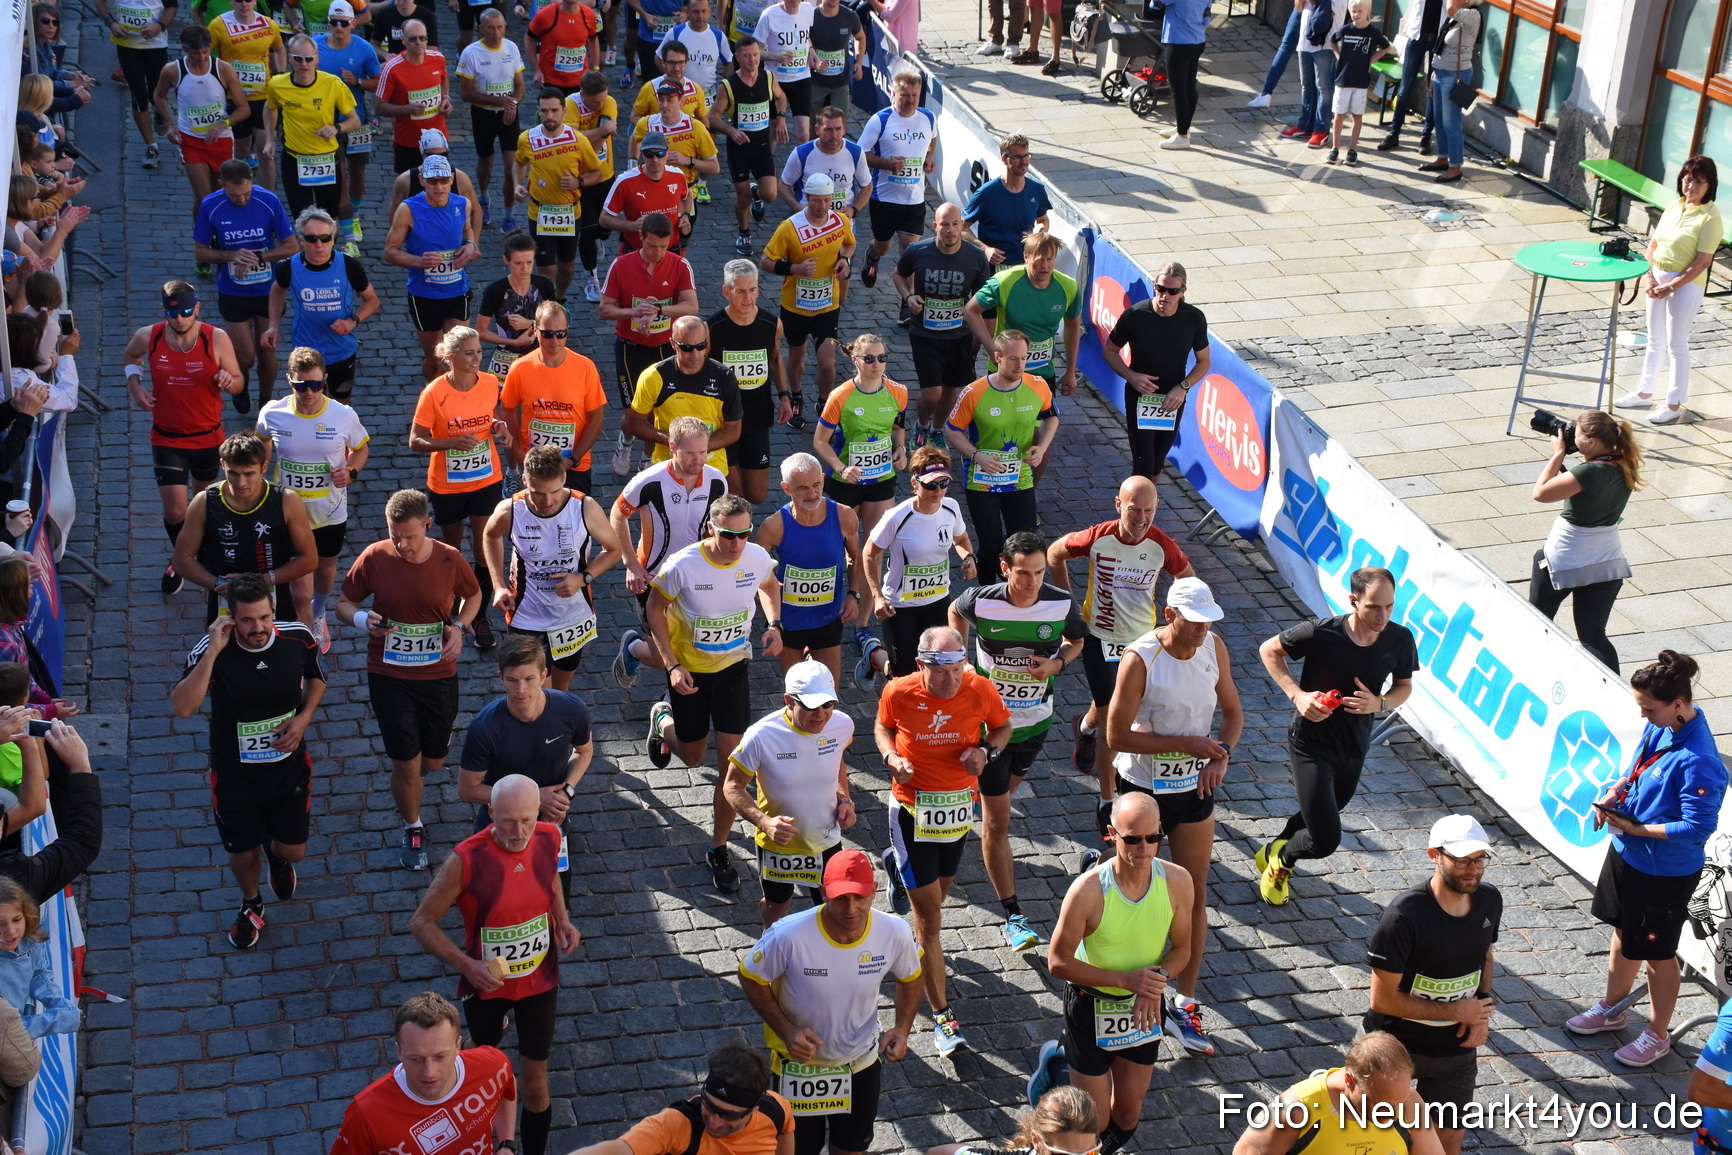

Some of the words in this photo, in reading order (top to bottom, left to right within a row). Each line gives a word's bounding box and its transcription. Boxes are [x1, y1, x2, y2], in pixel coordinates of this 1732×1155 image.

[231, 36, 250, 45] MAX
[559, 55, 582, 65] 2298
[237, 71, 262, 82] 1234
[193, 112, 221, 126] 1405
[742, 112, 767, 122] 2130
[534, 150, 553, 161] MAX
[556, 145, 580, 156] BÖGL
[302, 166, 331, 176] 2737
[543, 214, 571, 224] 1131
[224, 228, 264, 240] SYSCAD
[802, 242, 824, 254] MAX
[826, 230, 846, 245] BÖGL
[925, 268, 965, 284] MUD
[801, 288, 830, 299] 2373
[924, 282, 964, 296] DER
[929, 309, 960, 320] 2426
[726, 352, 765, 362] BOCK
[1026, 350, 1048, 361] 705
[732, 364, 764, 377] 1126
[532, 423, 571, 434] BOCK
[1202, 379, 1262, 478] Hervis
[532, 432, 569, 448] 2753
[852, 439, 889, 454] BOCK
[855, 452, 889, 468] 2506
[1207, 438, 1232, 468] SPORTS
[284, 462, 326, 473] BOCK
[452, 455, 488, 470] 2754
[286, 474, 325, 488] 1352
[532, 557, 574, 567] TEAM
[907, 562, 946, 576] BOCK
[790, 568, 832, 579] BOCK
[1117, 566, 1143, 574] FITNESS
[790, 581, 831, 594] 1006
[910, 575, 944, 591] 1042
[913, 590, 936, 598] SILVIA
[701, 613, 746, 628] BOCK
[555, 619, 593, 645] 1230
[701, 626, 743, 642] 2775
[392, 636, 436, 652] 2314
[556, 632, 593, 654] WOLFGANG
[996, 683, 1039, 699] 2267
[915, 732, 961, 745] funrunners
[928, 738, 967, 748] neumarkt
[1160, 757, 1204, 777] 2476
[922, 793, 968, 807] BOCK
[923, 807, 968, 825] 1010
[920, 825, 968, 835] HANS-WERNER
[769, 855, 816, 871] 1028
[768, 869, 817, 881] CHRISTOPH
[487, 922, 543, 941] BOCK
[491, 938, 543, 960] 1224
[858, 961, 887, 969] Neumarkter
[860, 953, 871, 963] 20
[509, 959, 535, 972] ETER
[1421, 976, 1475, 992] BOCK
[1107, 1026, 1153, 1047] ANDREAS
[789, 1079, 843, 1098] 1097
[410, 1111, 446, 1135] raumbox
